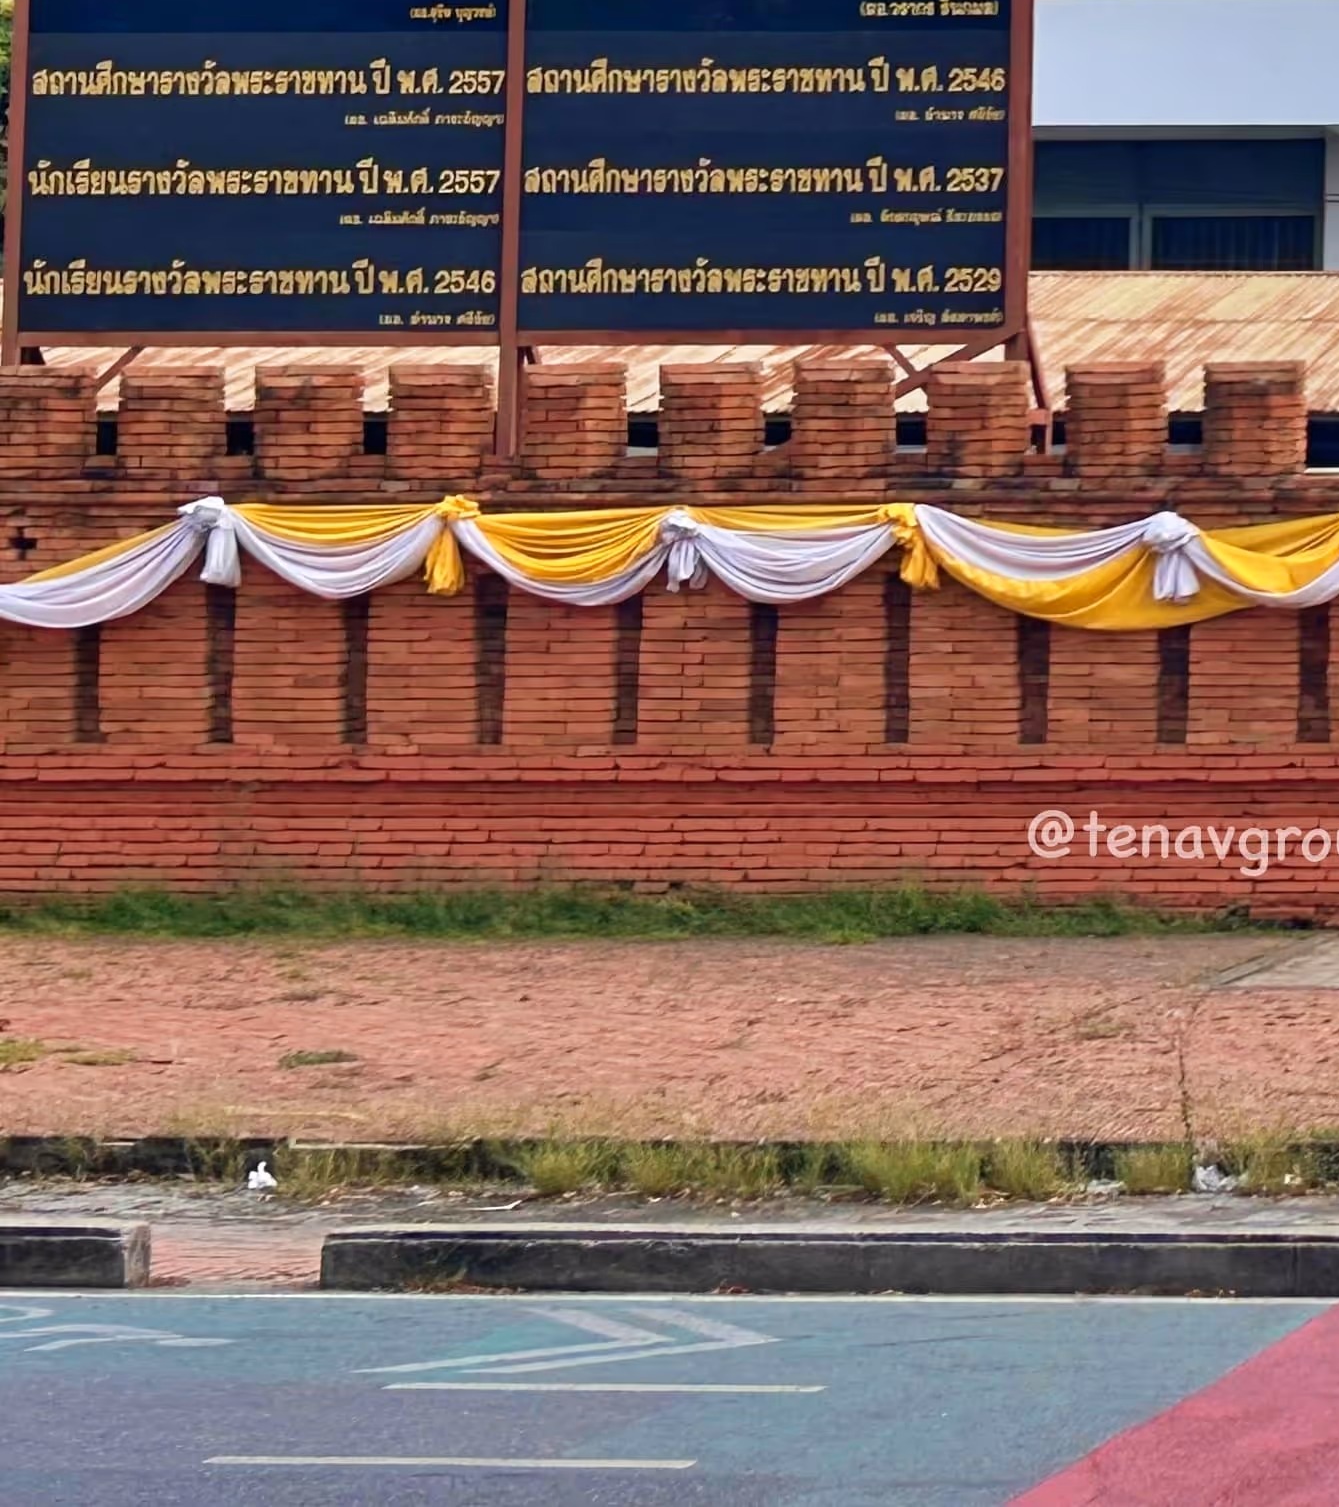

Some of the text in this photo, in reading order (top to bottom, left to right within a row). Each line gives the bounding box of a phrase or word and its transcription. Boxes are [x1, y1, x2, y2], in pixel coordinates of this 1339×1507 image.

[32, 57, 506, 96] สถานศึกษารางวัลพระราชทาน ปี พ.ศ. 2557
[526, 56, 1006, 94] สถานศึกษารางวัลพระราชทาน ปี พ.ศ. 2546
[28, 157, 501, 196] นักเรียนรางวัลพระราชทาน ปี พ.ศ. 2557
[524, 156, 1005, 194] สถานศึกษารางวัลพระราชทาน ปี พ.ศ. 2537
[23, 258, 496, 296] นักเรียนรางวัลพระราชทาน ปี พ.ศ. 2546
[520, 256, 1002, 294] สถานศึกษารางวัลพระราชทาน ปี พ.ศ. 2529
